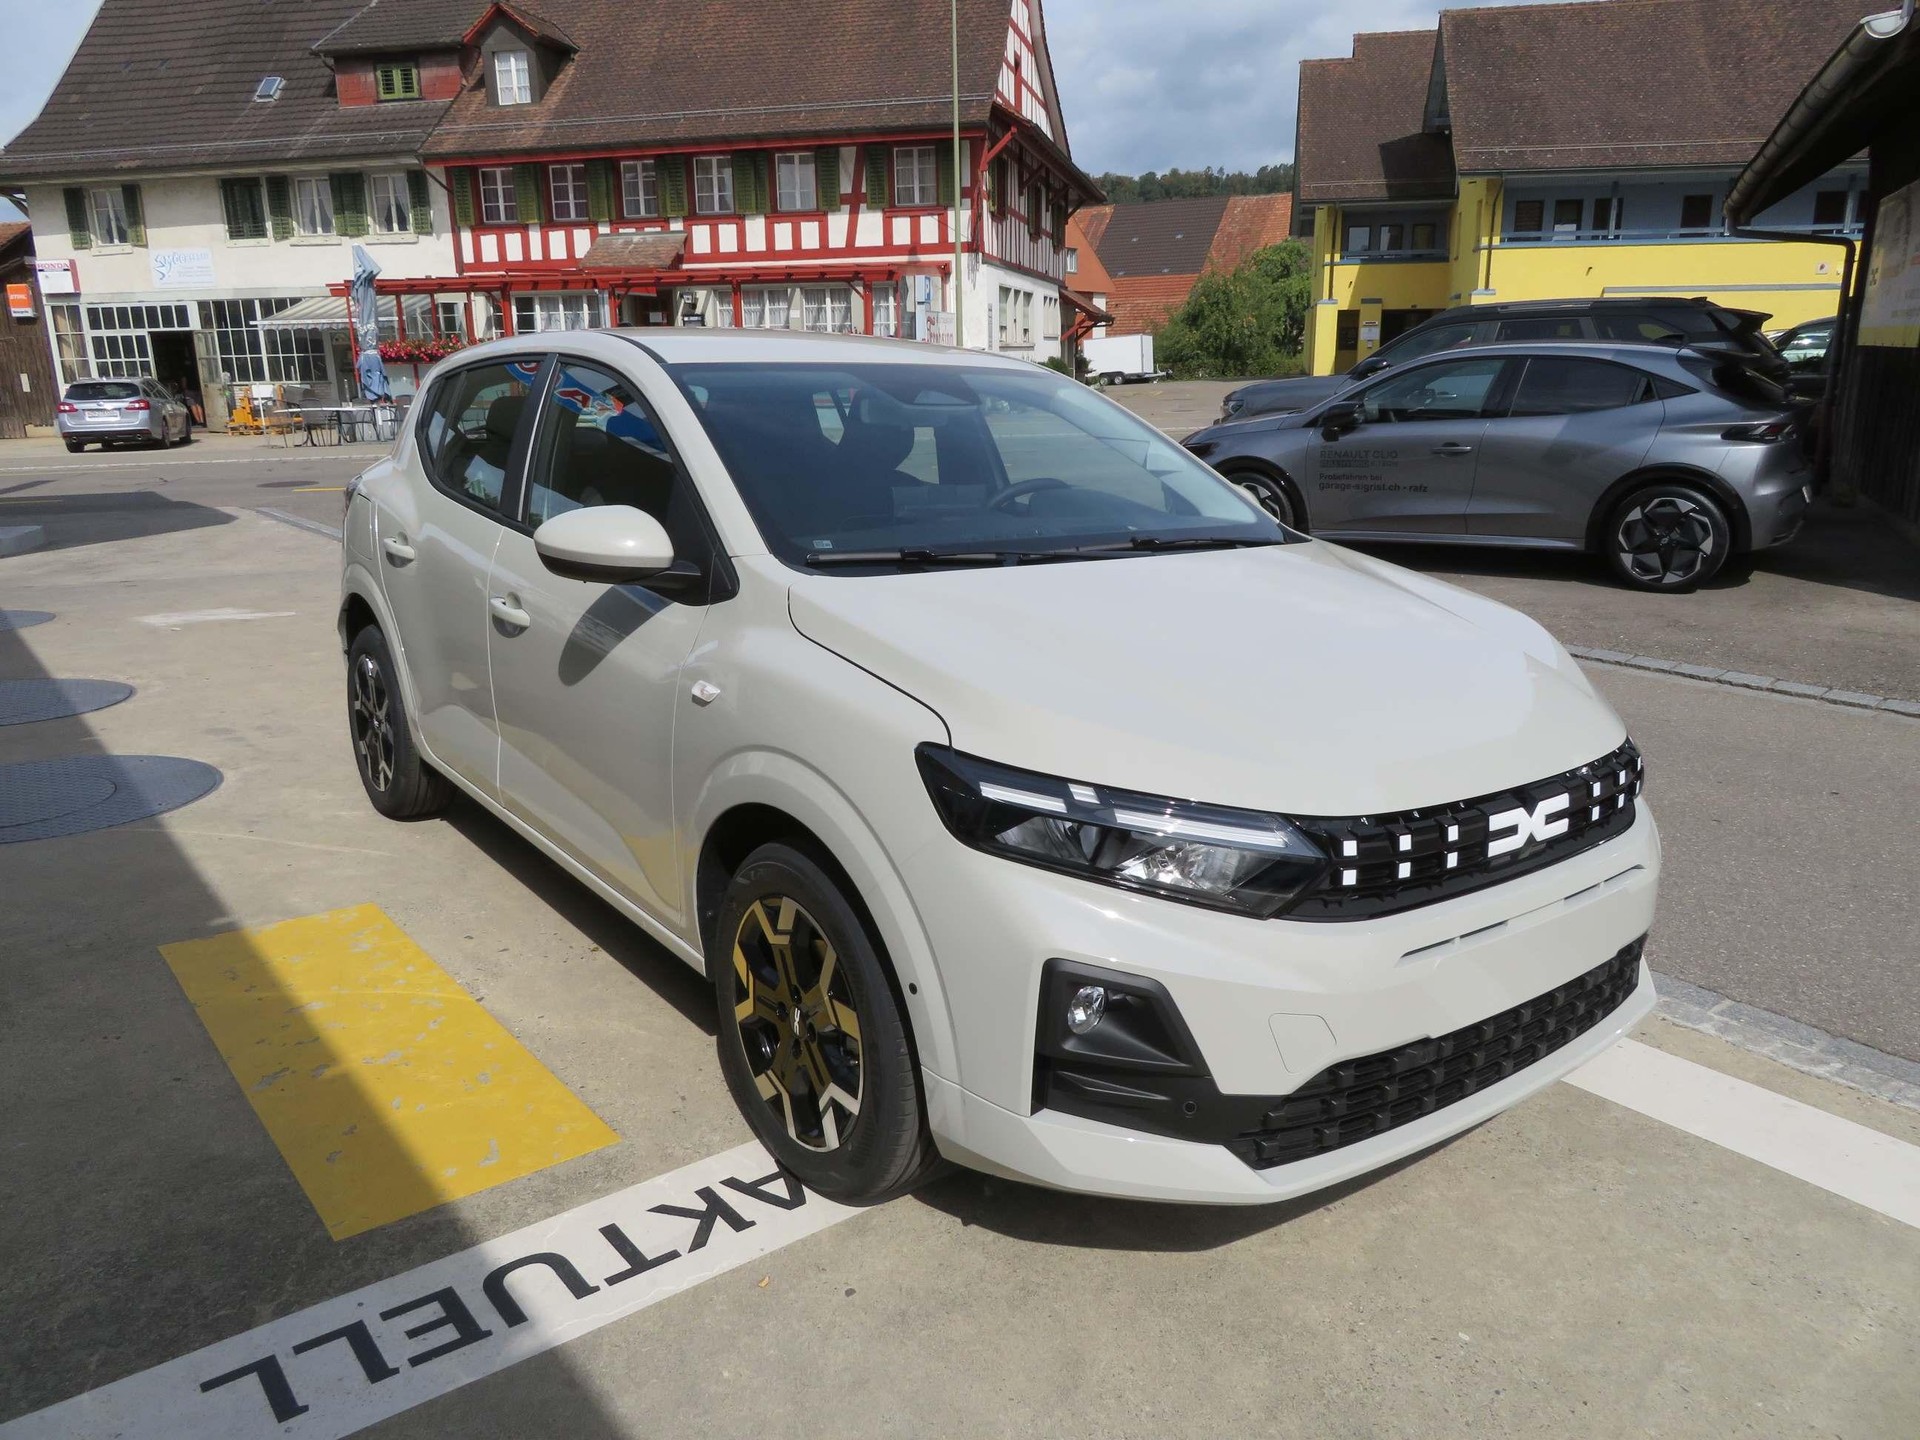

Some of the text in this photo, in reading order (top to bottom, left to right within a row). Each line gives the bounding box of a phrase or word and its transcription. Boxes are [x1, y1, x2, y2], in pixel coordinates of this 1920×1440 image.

[1319, 450, 1399, 460] RENAULT CLIO
[199, 1158, 808, 1424] AKTUELL
